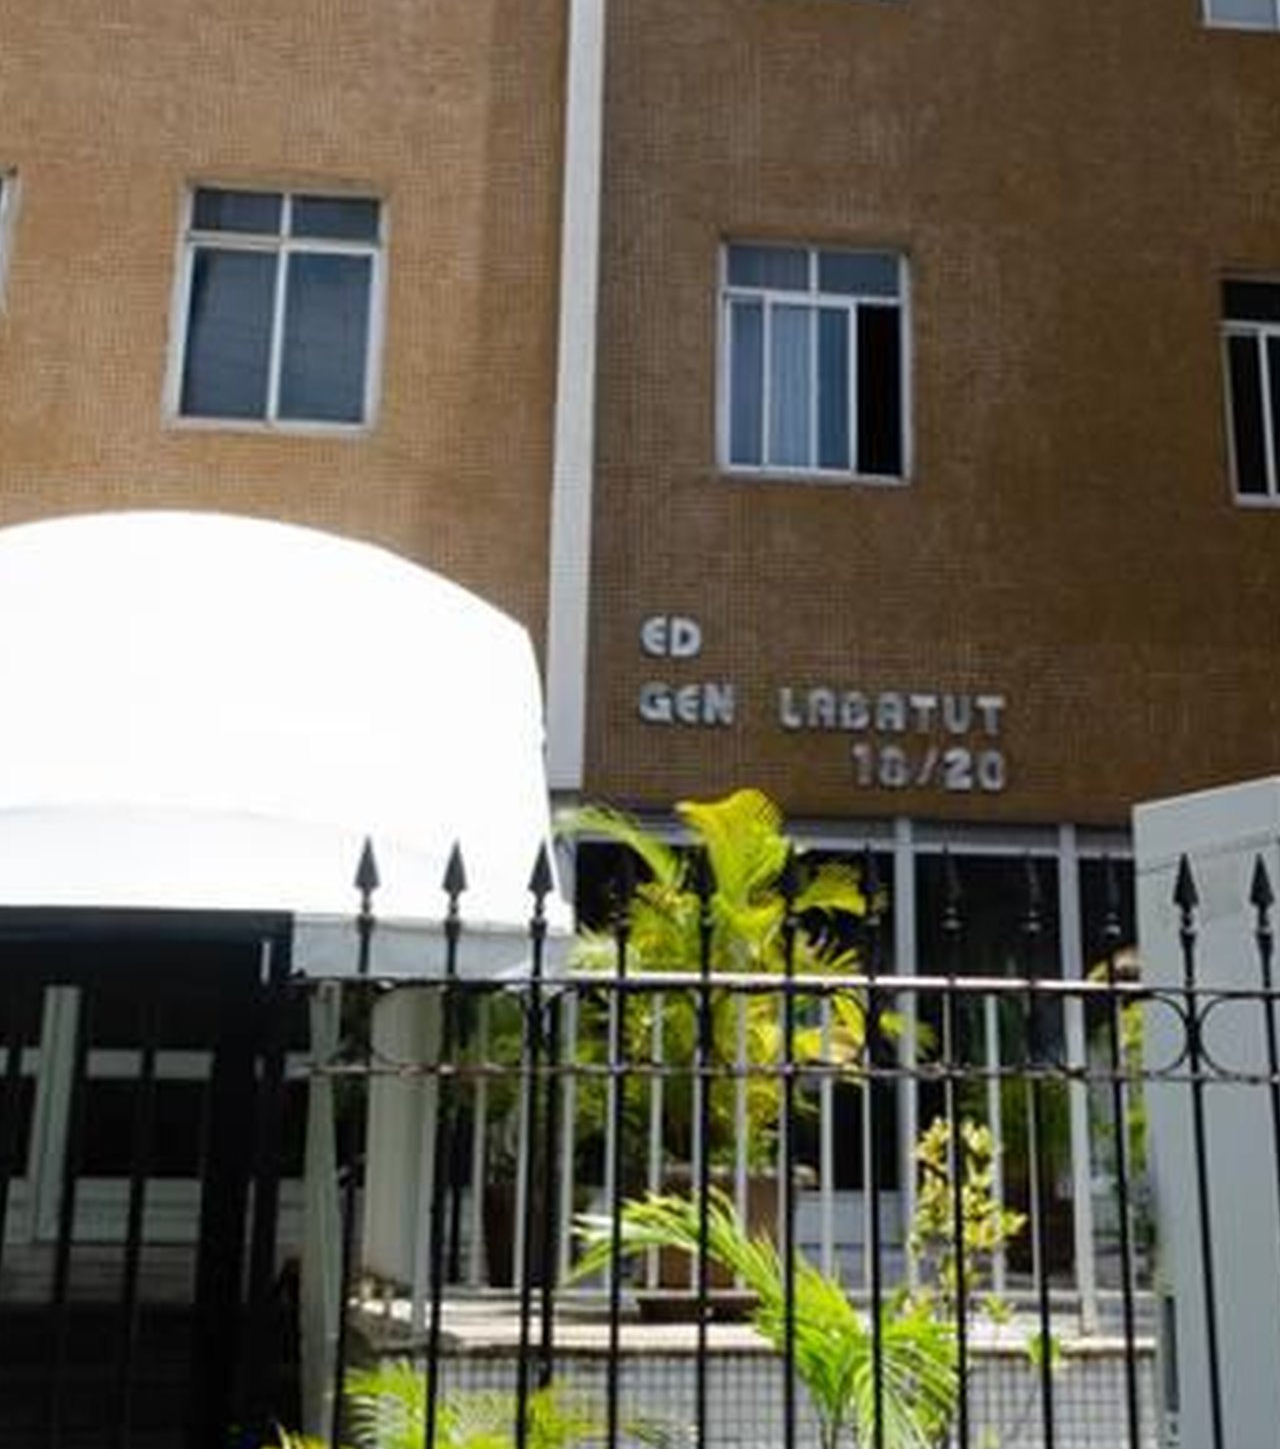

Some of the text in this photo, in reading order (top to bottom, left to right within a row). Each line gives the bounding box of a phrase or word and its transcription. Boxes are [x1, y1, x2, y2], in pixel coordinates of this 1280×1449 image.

[641, 616, 702, 657] ED
[638, 682, 1007, 735] GEN LABATUT
